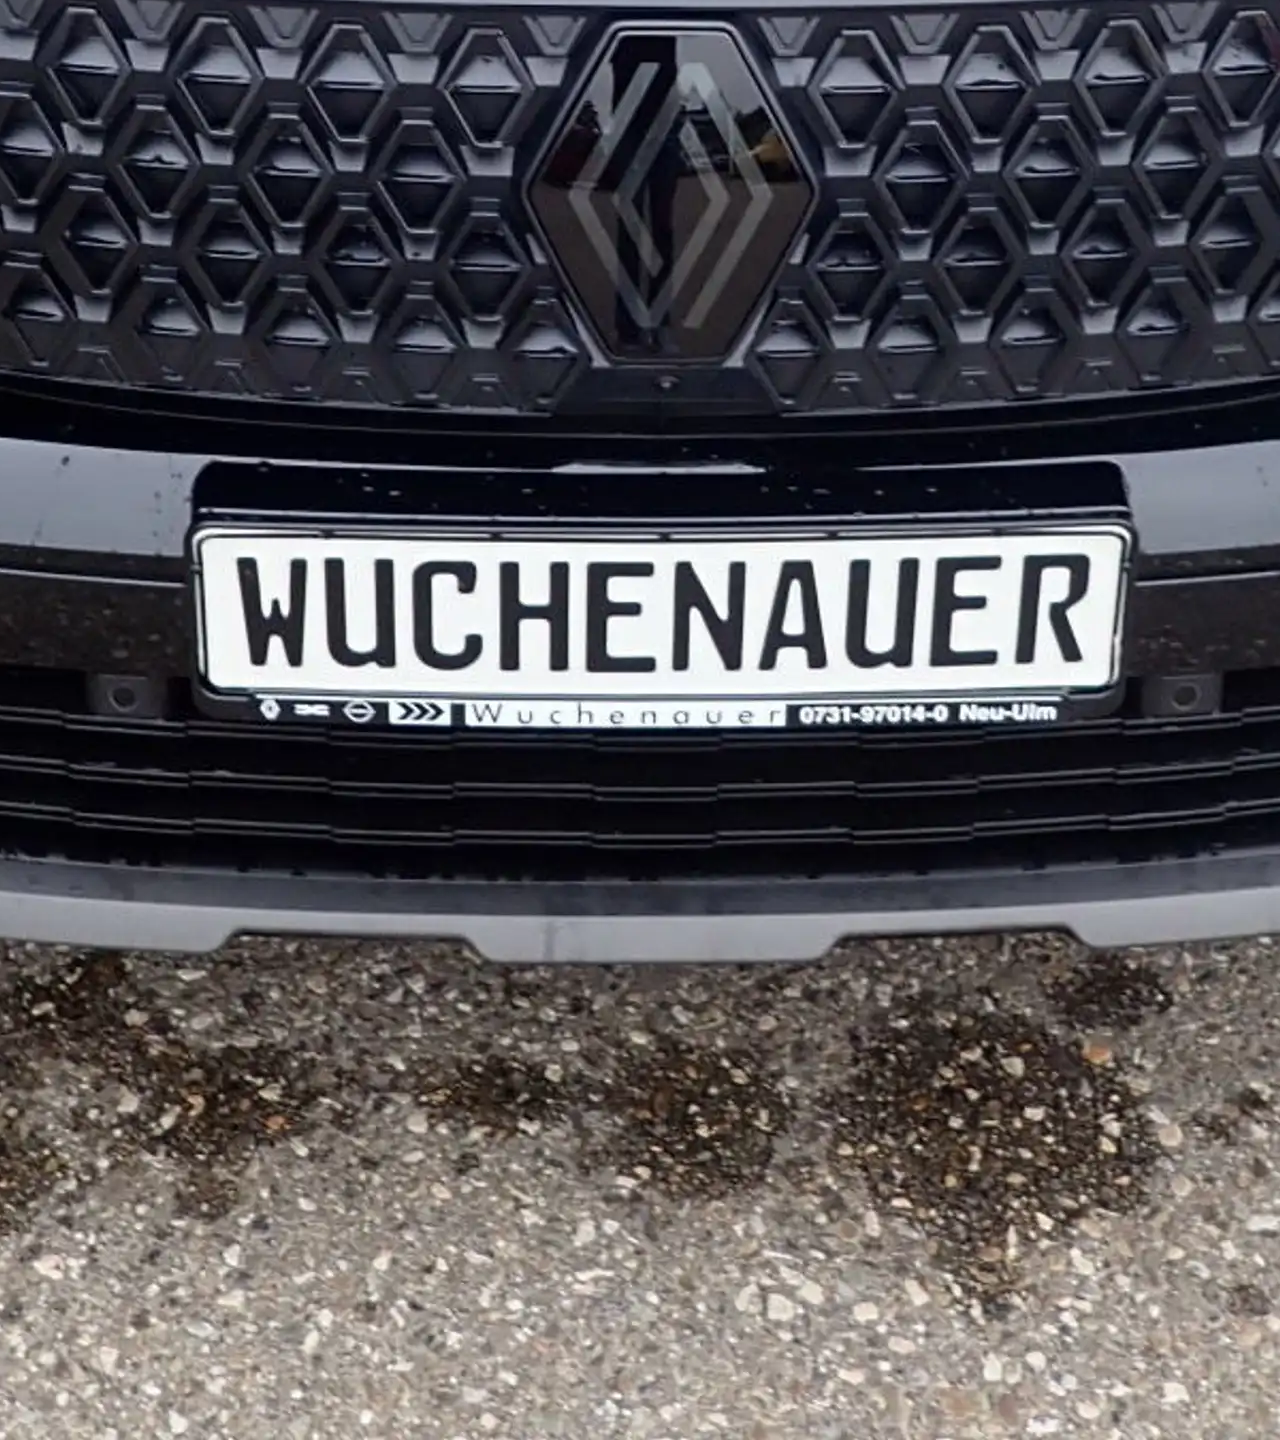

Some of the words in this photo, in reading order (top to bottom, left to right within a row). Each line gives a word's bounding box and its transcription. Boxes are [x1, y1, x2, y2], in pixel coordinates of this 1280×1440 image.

[236, 555, 1090, 673] WUCHENAUER
[471, 702, 782, 726] Wuchenauer
[798, 705, 949, 725] 0731-97014-0
[958, 702, 1058, 723] Neu-Ulm
